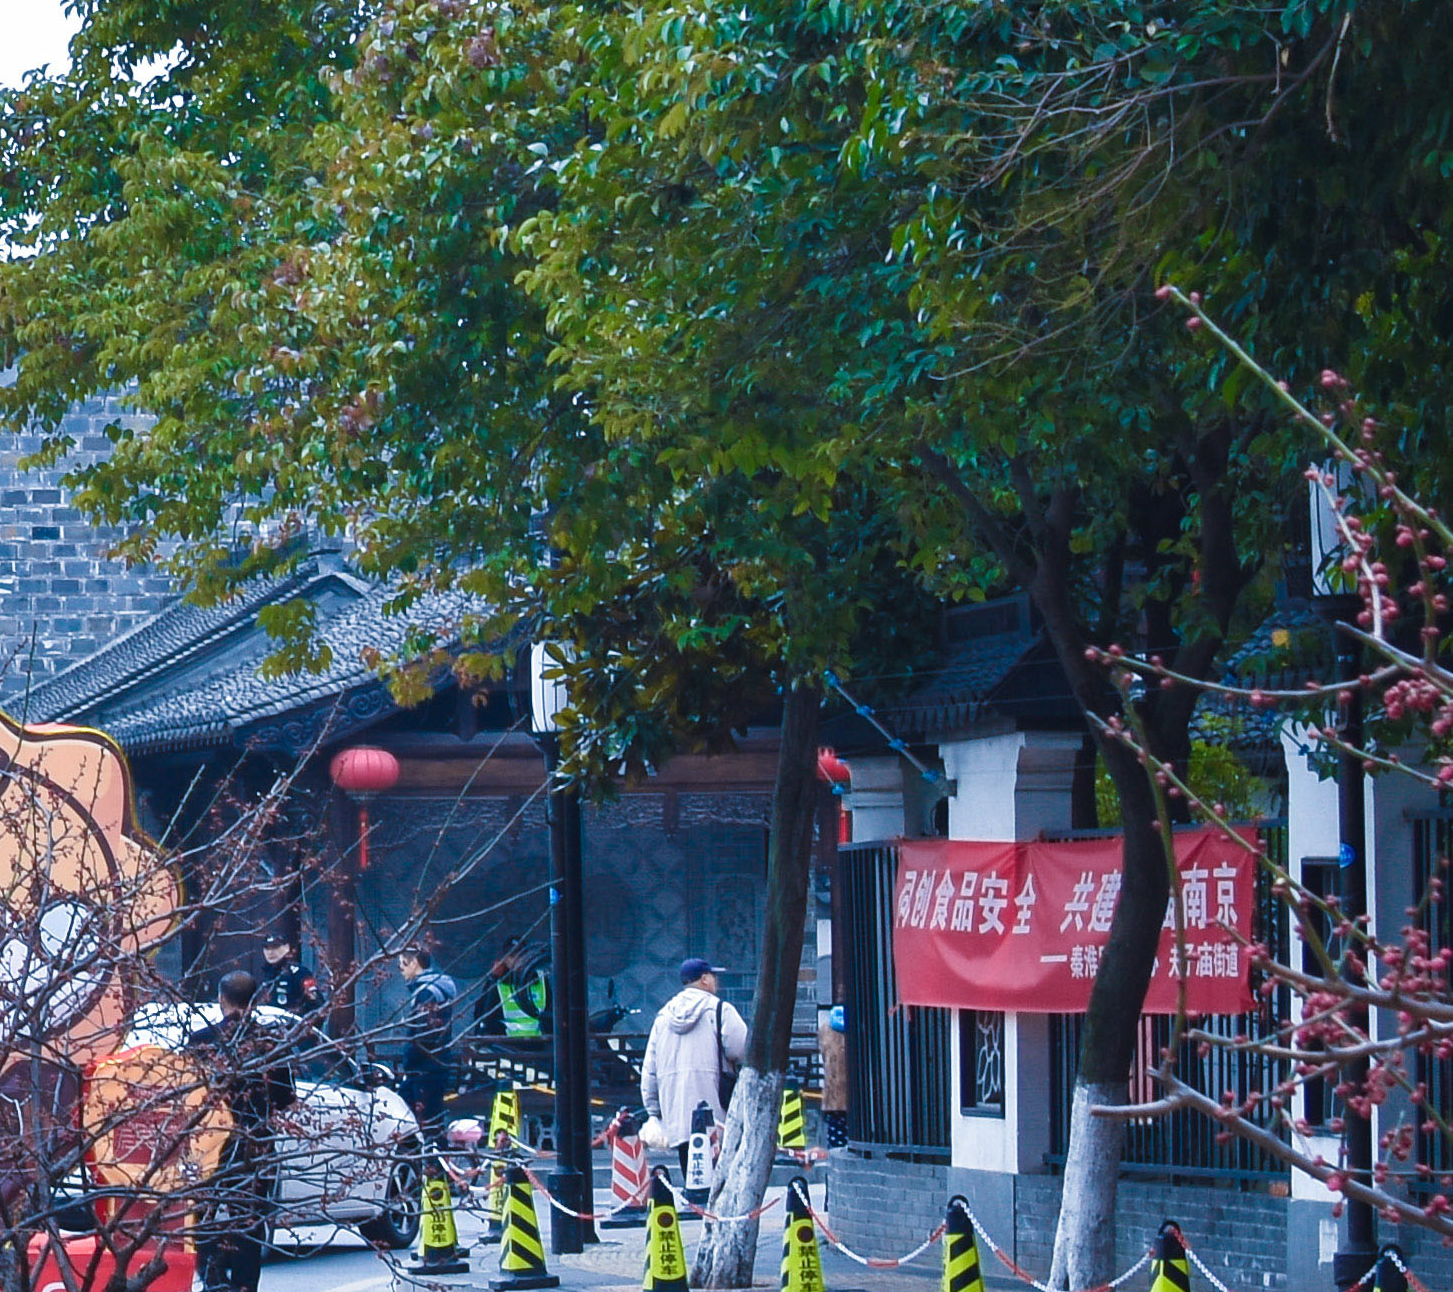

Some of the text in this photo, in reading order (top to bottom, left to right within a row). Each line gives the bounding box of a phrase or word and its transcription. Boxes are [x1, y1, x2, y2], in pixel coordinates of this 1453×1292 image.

[1060, 861, 1239, 934] 共建南京
[658, 1230, 678, 1276] 禁止停车
[798, 1245, 819, 1292] 禁止停车
